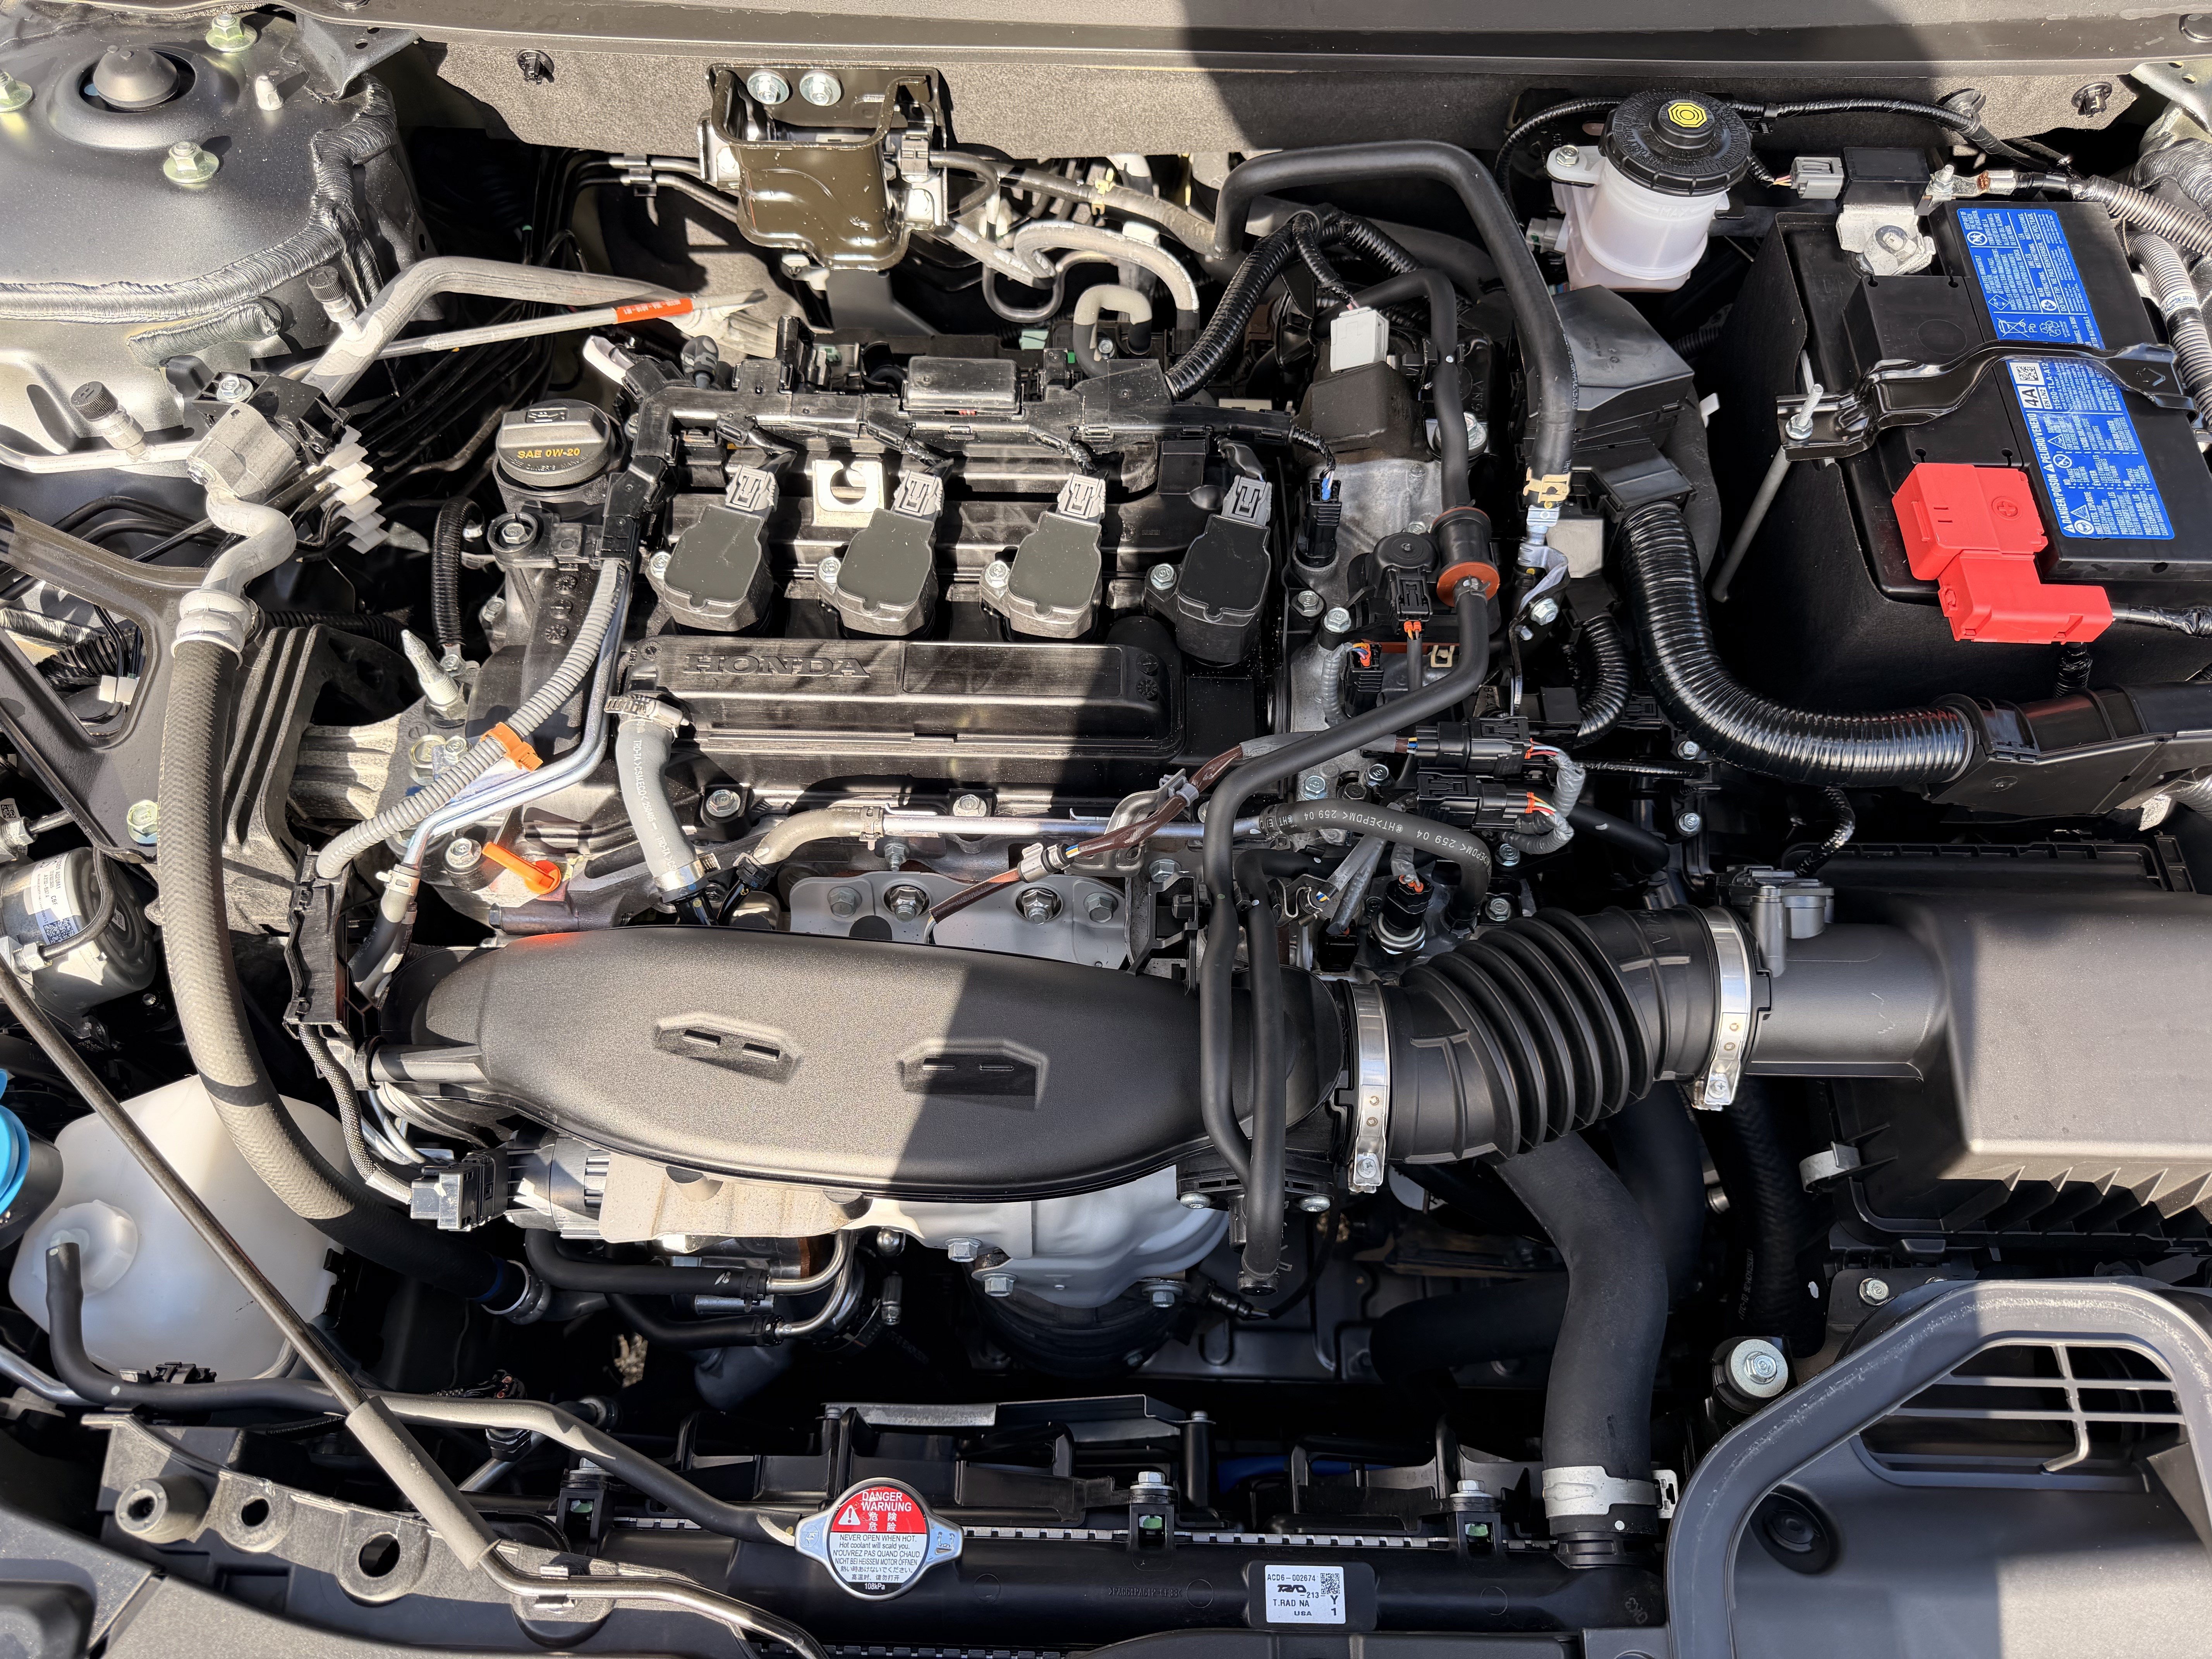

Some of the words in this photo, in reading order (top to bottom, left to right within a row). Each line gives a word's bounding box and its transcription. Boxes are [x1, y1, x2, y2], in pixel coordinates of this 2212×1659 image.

[1628, 141, 1649, 156] ONLY
[1664, 156, 1715, 168] WARNING
[2027, 213, 2039, 232] VOLTEAR.
[2038, 242, 2051, 268] RENVERSER.
[2056, 294, 2064, 304] NOT
[2028, 323, 2037, 333] Pb
[2083, 316, 2095, 337] MATERIALS
[2042, 362, 2062, 409] 31500-TLA-A12
[2022, 389, 2039, 406] 4A
[2112, 400, 2121, 411] MADE
[2027, 414, 2051, 463] PELIGRO/VENENO
[517, 450, 542, 459] SAE
[545, 448, 580, 458] 0W-20
[2066, 469, 2076, 482] SPARKS
[2073, 468, 2083, 482] FLAMES
[2078, 466, 2090, 483] SMOKING
[2089, 471, 2101, 486] ÉVITER
[2047, 474, 2071, 523] DANGER/POISON
[684, 653, 871, 677] HONDA
[1304, 812, 1314, 821] 04
[1318, 810, 1337, 819] 259
[1416, 830, 1429, 841] 04
[1435, 835, 1456, 848] 259
[862, 1492, 903, 1501] DANGER
[862, 1502, 912, 1511] WARNUNG
[1330, 1595, 1338, 1604] Y
